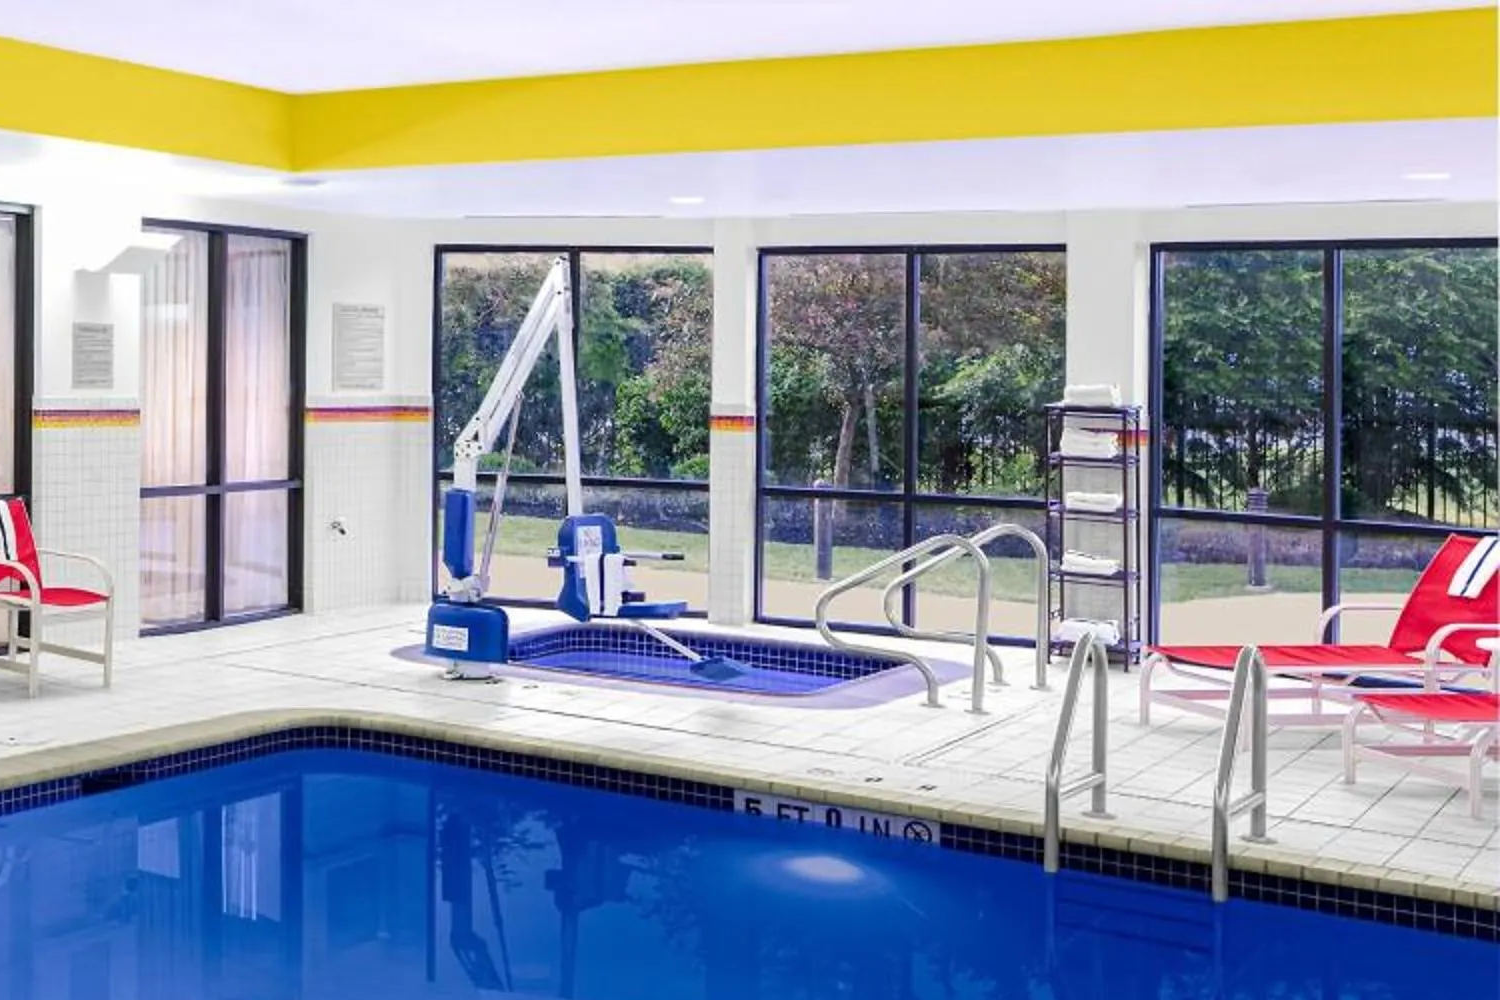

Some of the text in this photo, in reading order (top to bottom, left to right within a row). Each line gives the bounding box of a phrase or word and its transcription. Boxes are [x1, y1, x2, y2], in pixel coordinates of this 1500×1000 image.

[745, 797, 762, 817] 5
[777, 803, 810, 824] FT
[860, 815, 890, 838] IN
